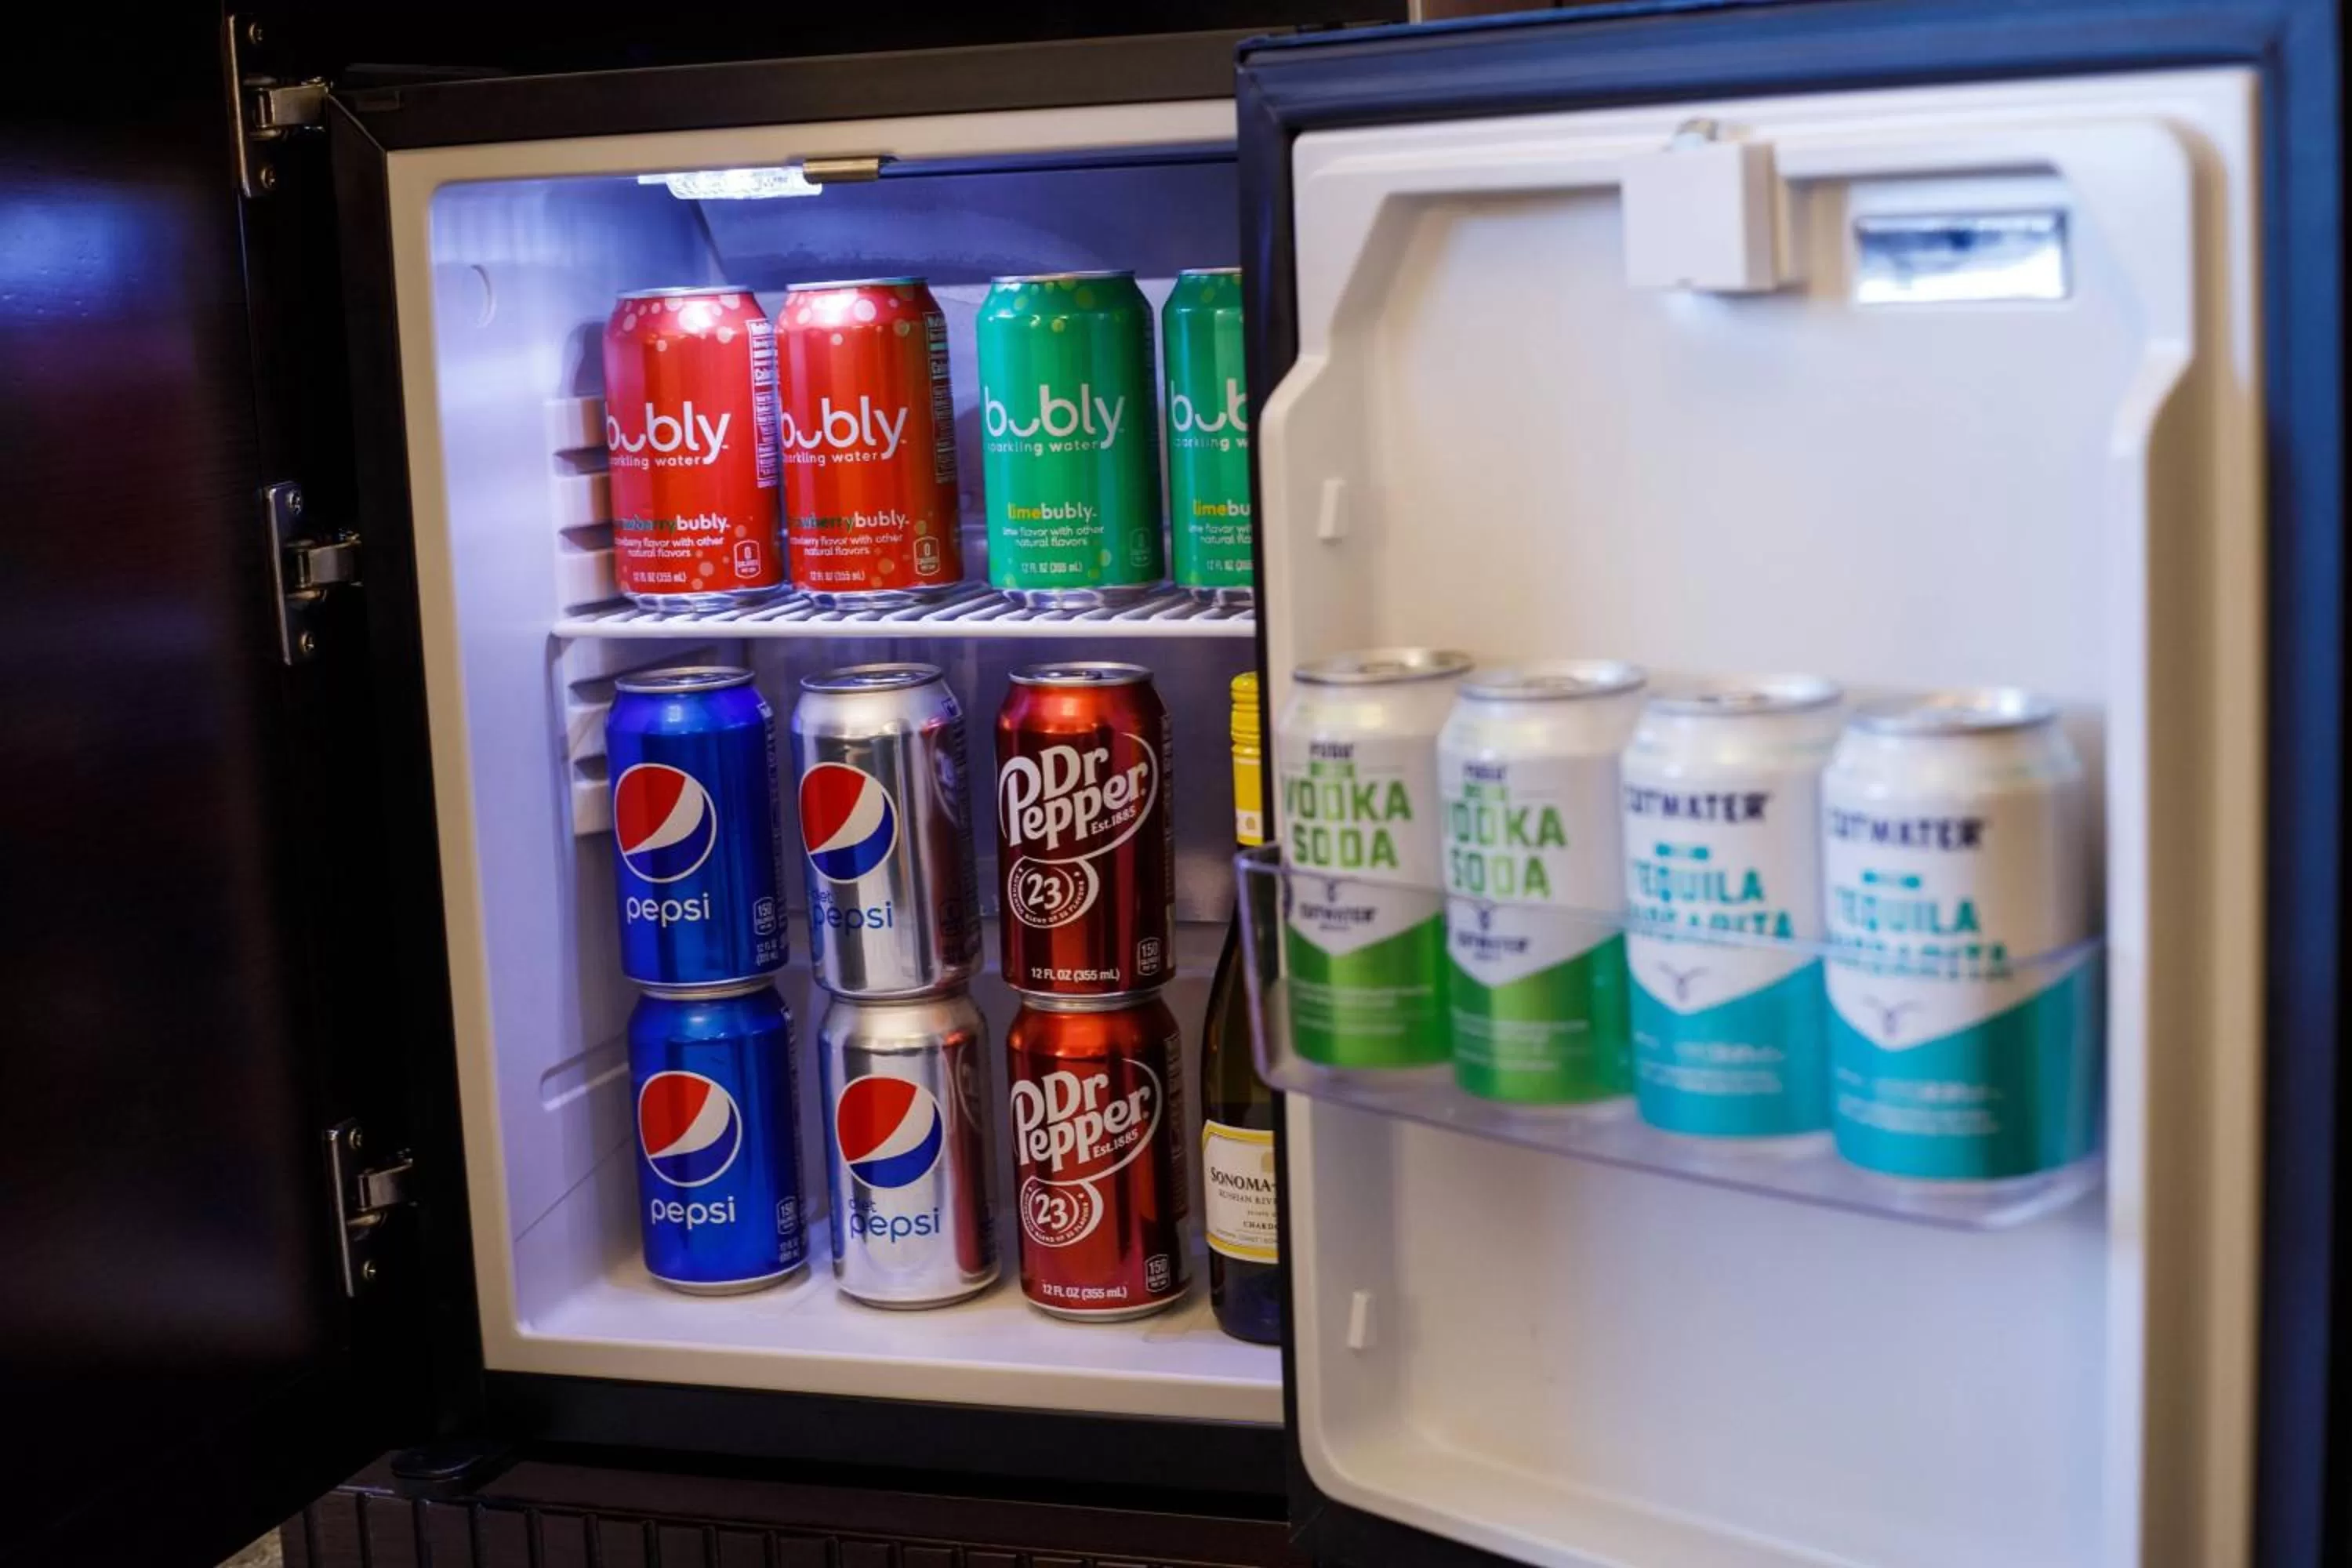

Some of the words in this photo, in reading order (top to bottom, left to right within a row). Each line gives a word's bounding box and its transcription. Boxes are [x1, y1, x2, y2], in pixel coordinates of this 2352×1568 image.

[985, 383, 1126, 449] bubly
[1171, 378, 1248, 432] bub
[655, 455, 700, 466] water
[832, 452, 877, 463] water
[1050, 440, 1096, 452] water
[1192, 499, 1251, 516] limebu
[673, 537, 694, 546] with
[851, 534, 873, 544] with
[1051, 525, 1073, 536] with
[1040, 745, 1109, 800] Dr
[1444, 801, 1569, 849] ODKA
[1293, 823, 1399, 869] SODA
[1027, 873, 1062, 910] 23
[626, 892, 710, 928] pepsi
[812, 902, 893, 935] pepsi
[1031, 967, 1043, 978] 12
[1044, 967, 1056, 979] FL
[1058, 969, 1072, 980] OZ
[1073, 969, 1098, 982] (355
[1099, 967, 1120, 982] mL)
[1041, 1071, 1109, 1124] Dr
[1210, 1166, 1276, 1192] SONOMA-
[652, 1196, 736, 1230] pepsi
[850, 1207, 941, 1243] pepsi
[1036, 1193, 1069, 1229] 23
[1243, 1220, 1278, 1230] CHARD
[1043, 1283, 1053, 1294] 12
[1054, 1284, 1065, 1298] FL
[1066, 1286, 1080, 1298] OZ
[1081, 1287, 1105, 1301] (355
[1106, 1286, 1127, 1299] mL)
